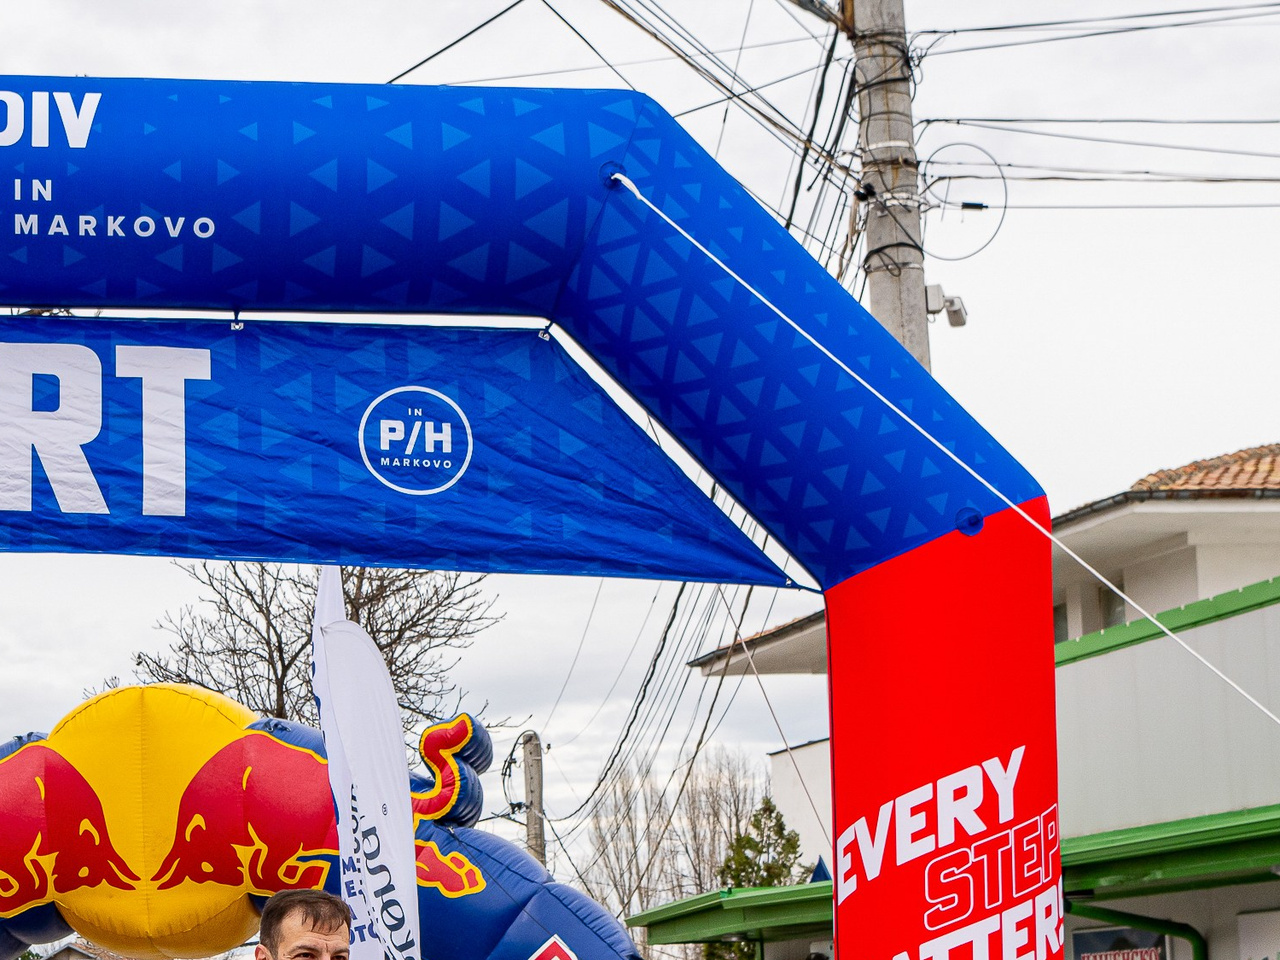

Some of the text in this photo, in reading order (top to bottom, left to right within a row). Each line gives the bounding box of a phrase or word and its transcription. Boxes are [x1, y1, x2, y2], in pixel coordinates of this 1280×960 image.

[14, 179, 52, 203] IN
[14, 214, 216, 239] MARKOVO
[408, 408, 423, 416] IN
[380, 419, 452, 455] P/H
[380, 457, 452, 469] MARKOVO
[837, 745, 1026, 906] EVERY
[923, 802, 1061, 931] STEP
